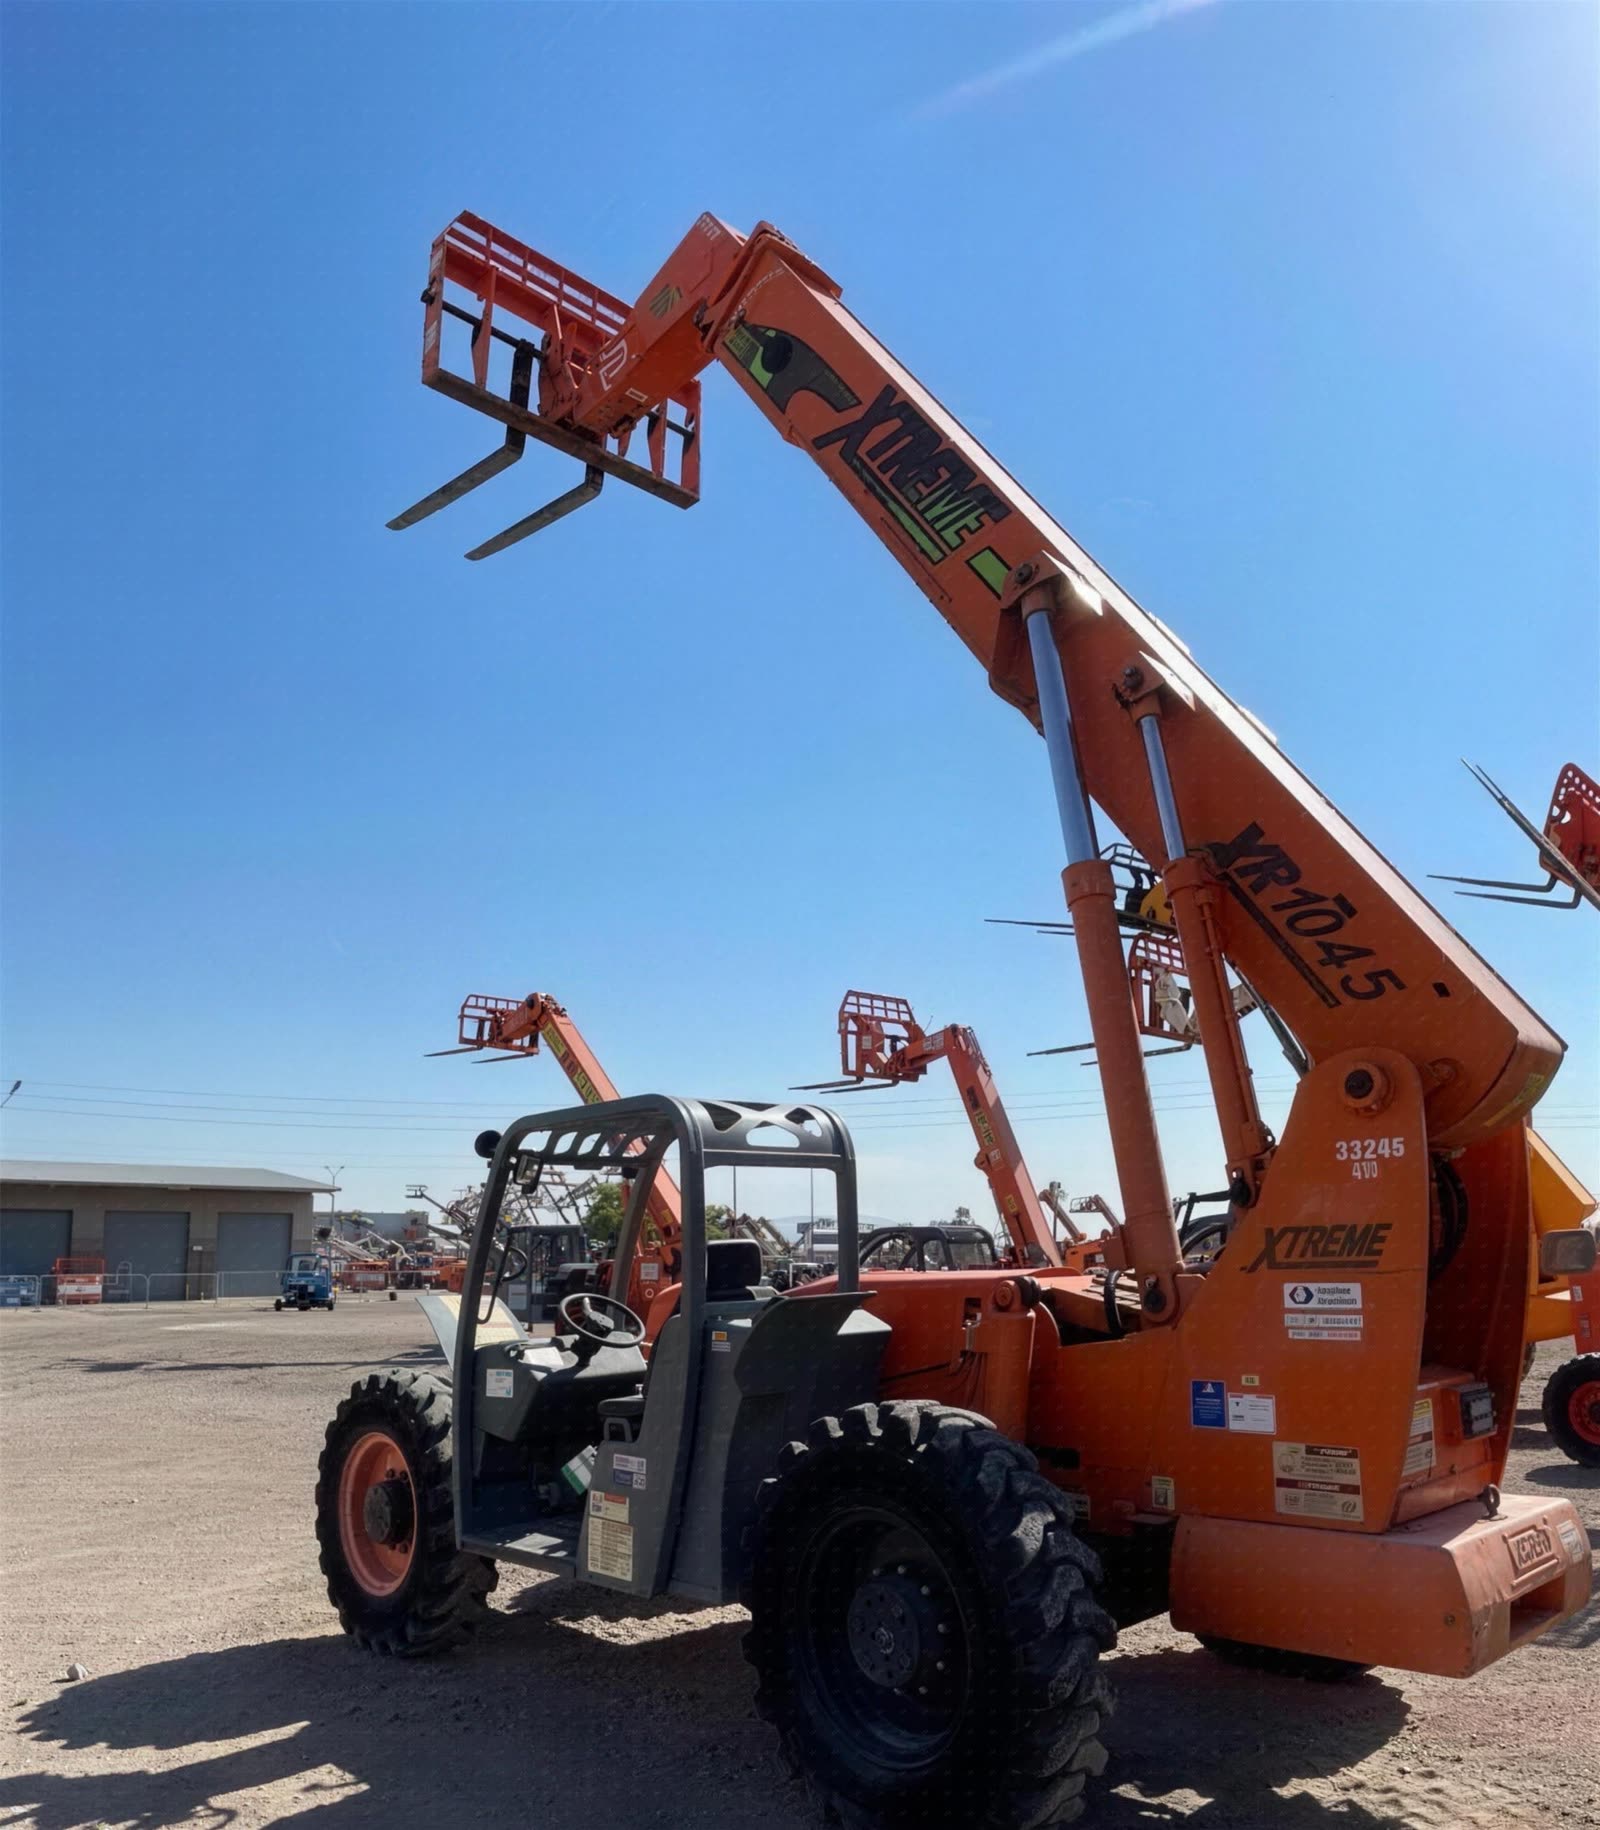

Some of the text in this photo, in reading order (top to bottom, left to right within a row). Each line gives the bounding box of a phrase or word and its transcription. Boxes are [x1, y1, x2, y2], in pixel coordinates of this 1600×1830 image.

[812, 384, 1012, 554] XTREME
[1207, 822, 1407, 1001] XR1045
[1335, 1137, 1405, 1161] 33245
[1243, 1223, 1393, 1273] XTREME
